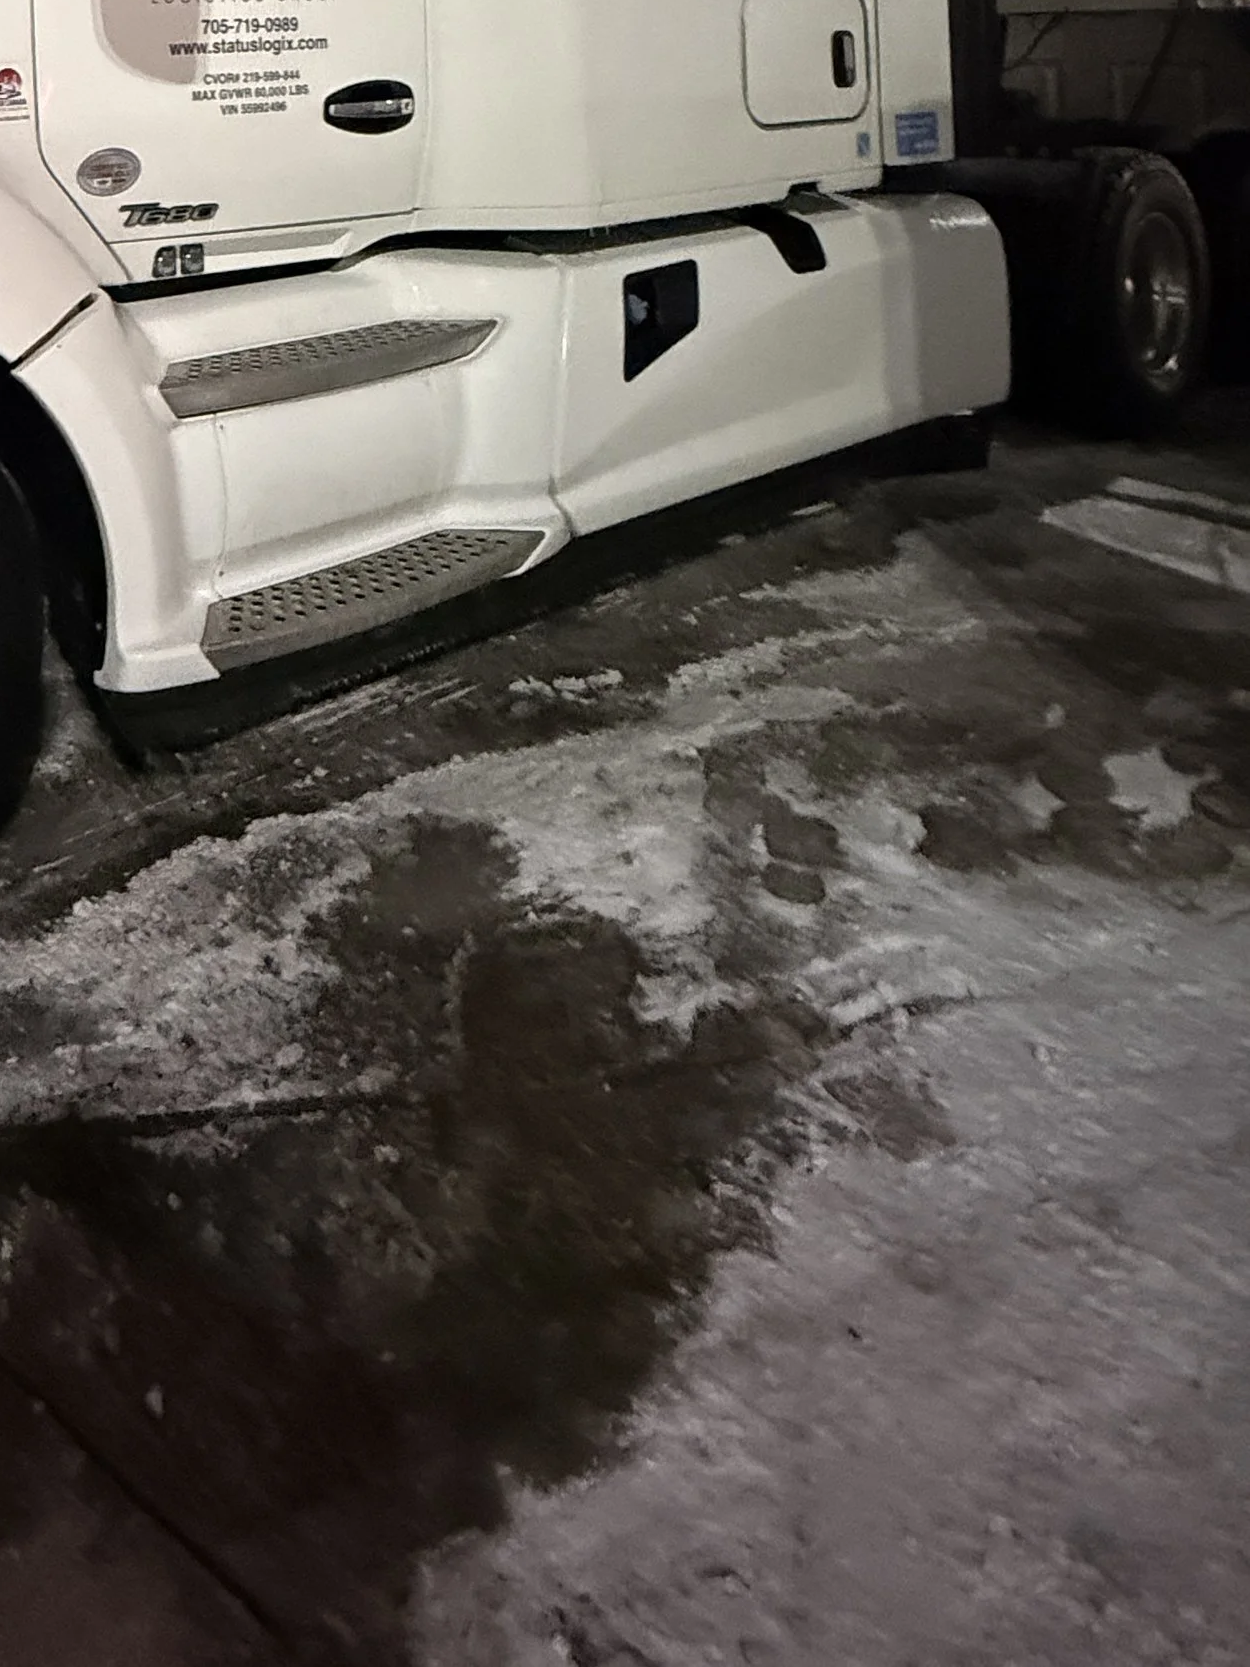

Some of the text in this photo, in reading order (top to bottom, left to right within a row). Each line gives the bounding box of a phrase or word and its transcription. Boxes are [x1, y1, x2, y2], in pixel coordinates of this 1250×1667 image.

[201, 17, 299, 34] 705-719-0989
[168, 36, 328, 55] www.statuslogix.com
[191, 90, 217, 101] MAX
[219, 87, 253, 100] GVWR
[288, 84, 310, 96] LBS
[219, 103, 239, 115] VIN
[118, 202, 219, 227] T680
